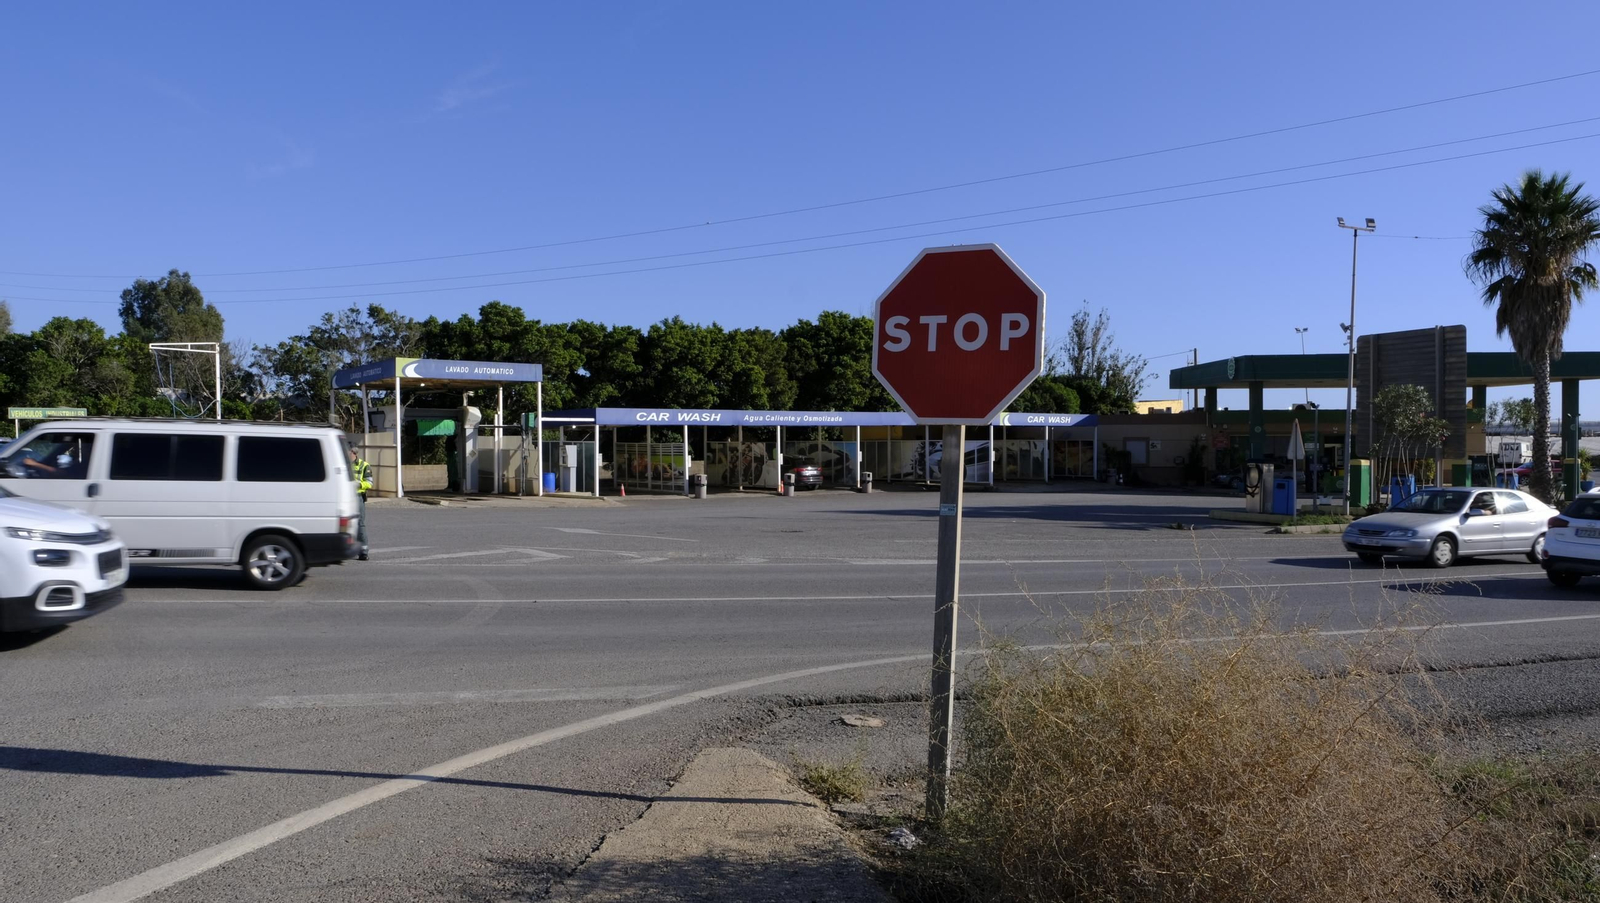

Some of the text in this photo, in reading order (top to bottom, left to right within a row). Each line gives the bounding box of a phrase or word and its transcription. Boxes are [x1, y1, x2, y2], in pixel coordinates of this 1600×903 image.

[883, 313, 1030, 352] STOP
[474, 367, 514, 375] AUTOMATICO
[636, 412, 722, 422] CAR WASH
[743, 414, 764, 423] Agua
[1027, 415, 1072, 424] CAR WASH
